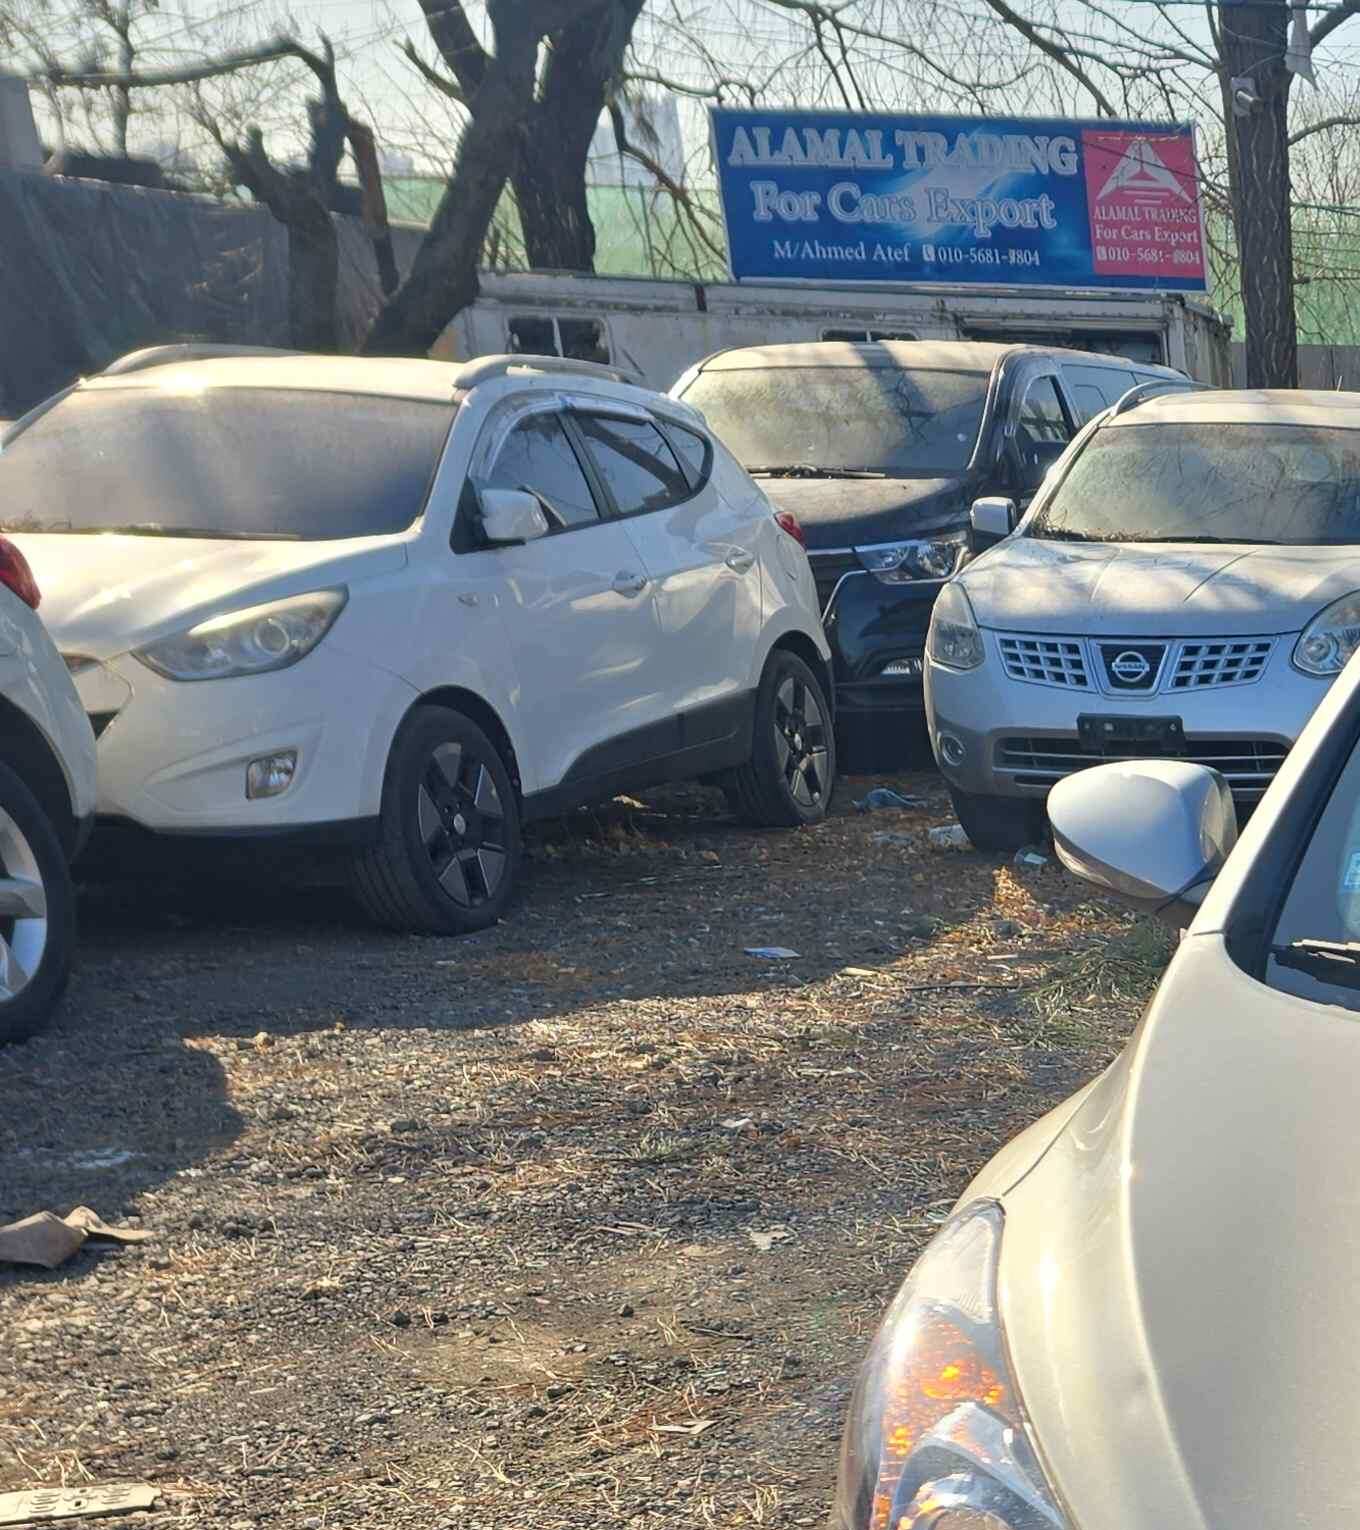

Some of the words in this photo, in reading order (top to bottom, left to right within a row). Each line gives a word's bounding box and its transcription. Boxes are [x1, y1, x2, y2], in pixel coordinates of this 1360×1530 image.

[728, 125, 894, 170] ALAMAL
[895, 129, 1078, 175] TRADING
[749, 180, 821, 223] For
[827, 181, 917, 223] Cars
[926, 184, 1057, 238] Export
[872, 242, 912, 263] Atef
[1095, 224, 1120, 240] For
[1121, 225, 1152, 241] Cars
[1153, 226, 1198, 247] Export
